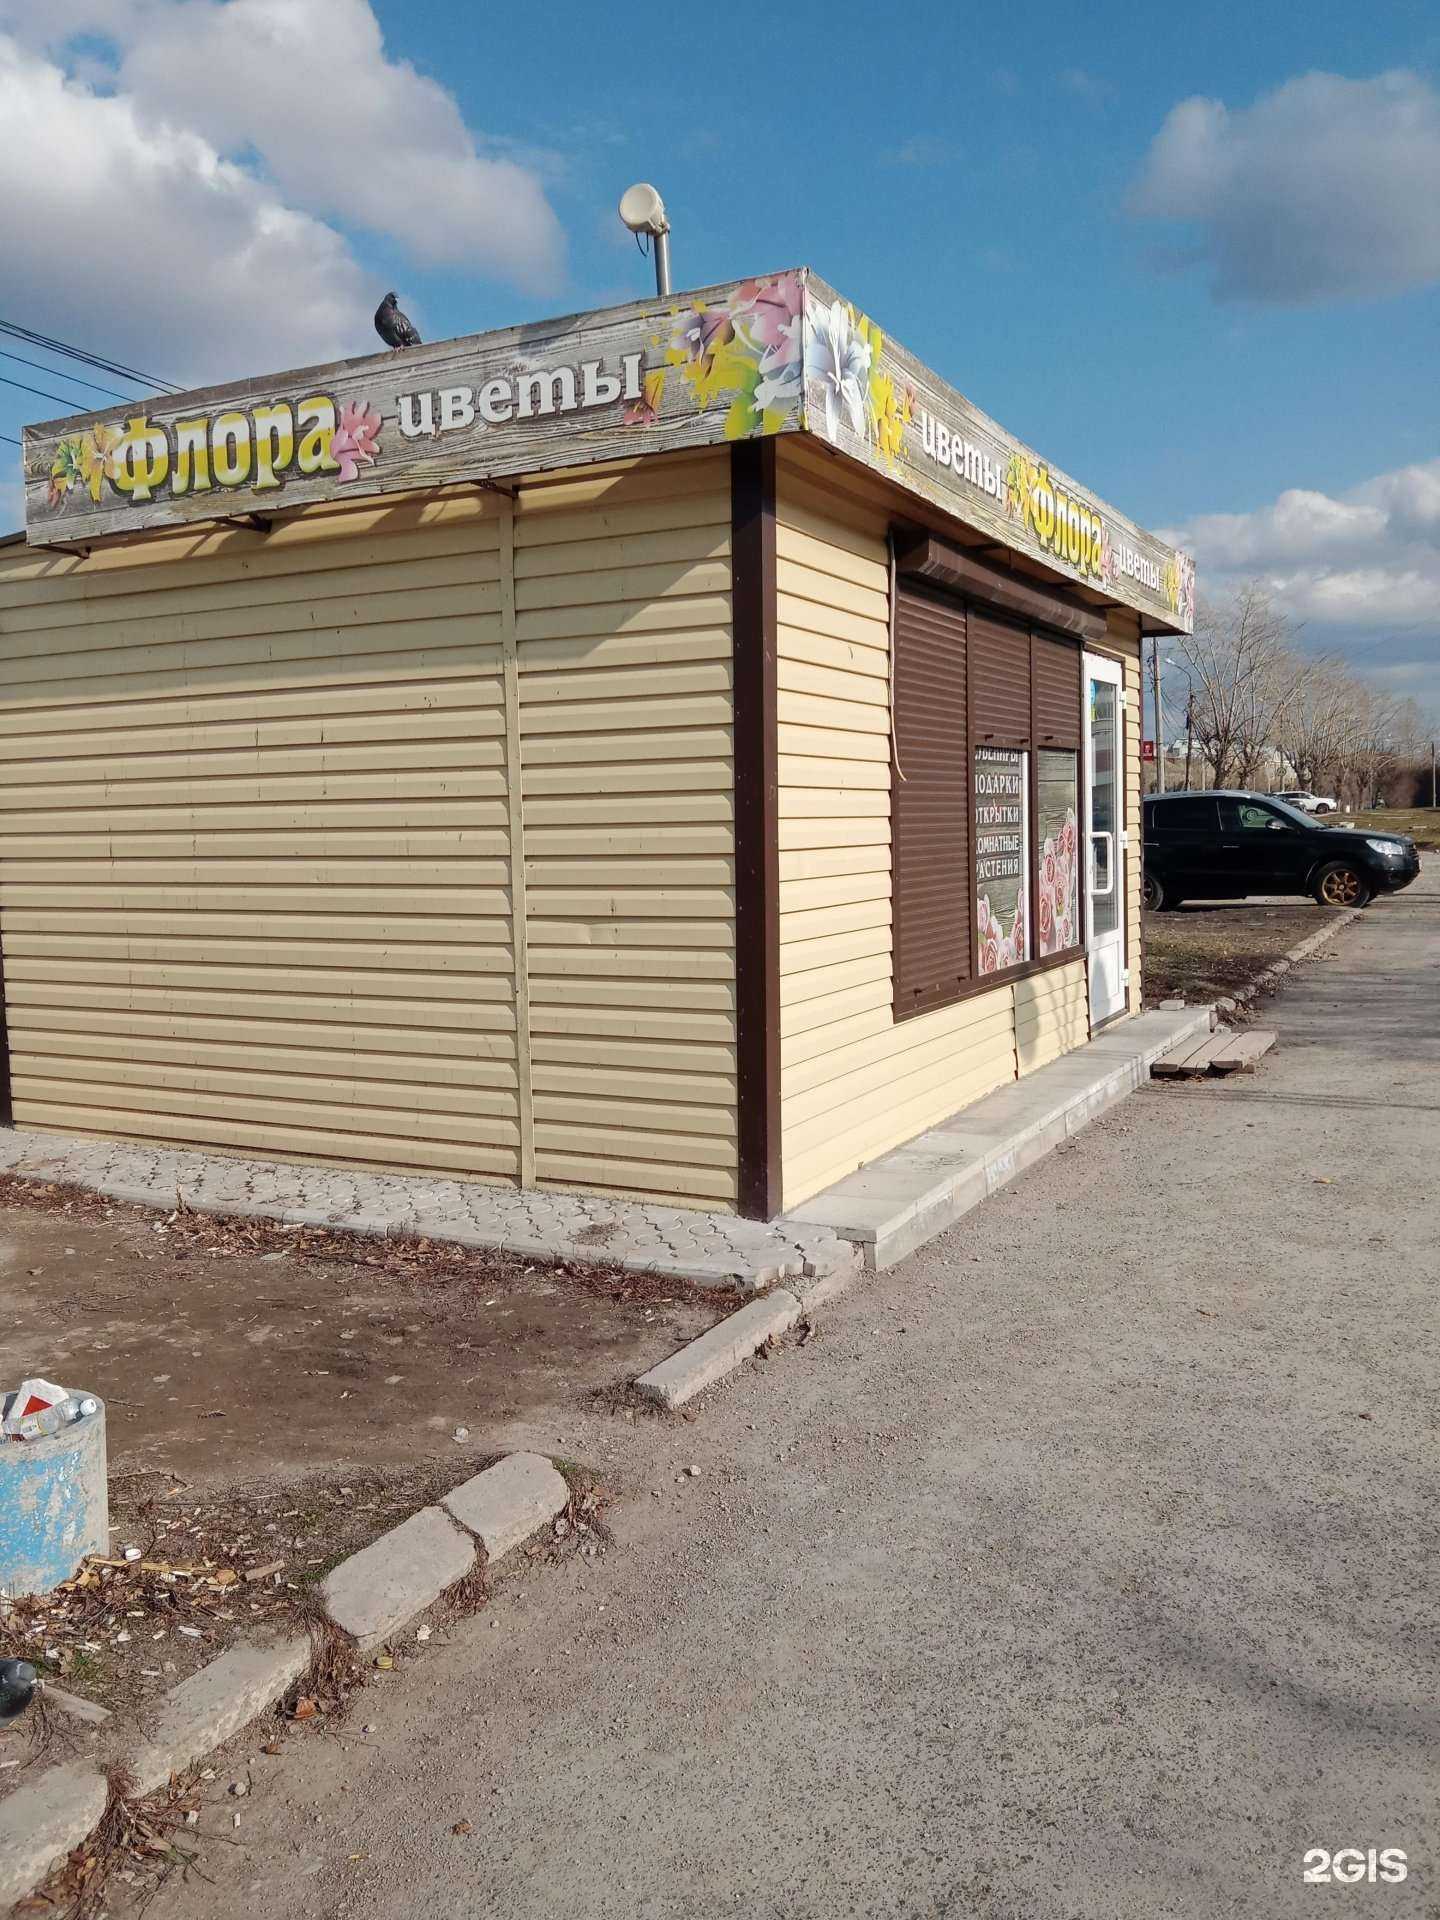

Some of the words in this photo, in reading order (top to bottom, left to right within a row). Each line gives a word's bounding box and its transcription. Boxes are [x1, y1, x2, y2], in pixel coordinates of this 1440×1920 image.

[112, 395, 340, 501] Флора
[398, 353, 643, 439] цветы
[921, 409, 1003, 500] цветы
[1030, 464, 1102, 580] Флора
[1119, 543, 1161, 592] цветы
[976, 835, 1020, 855] ОМНАТНЫЕ
